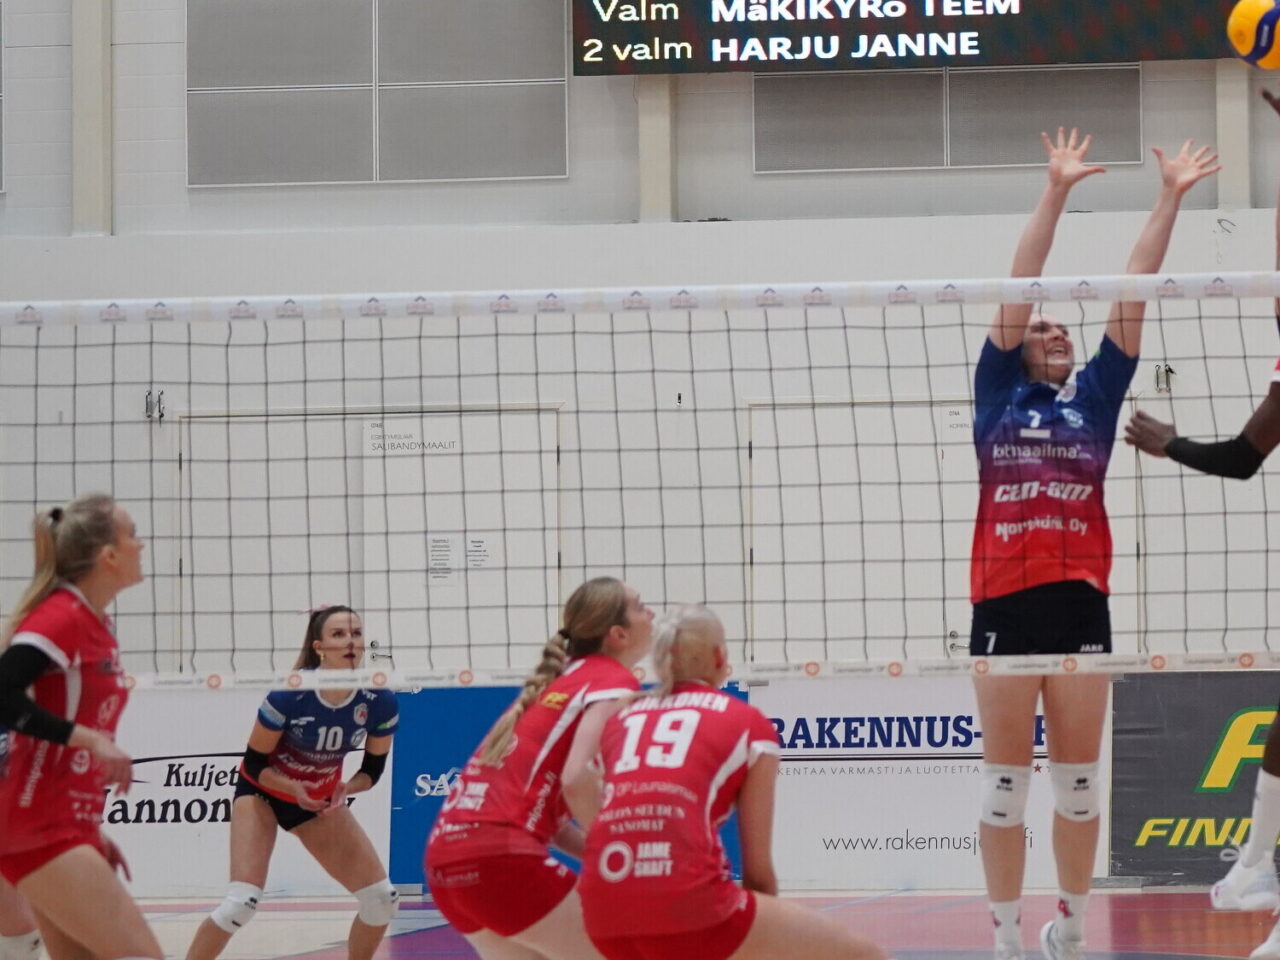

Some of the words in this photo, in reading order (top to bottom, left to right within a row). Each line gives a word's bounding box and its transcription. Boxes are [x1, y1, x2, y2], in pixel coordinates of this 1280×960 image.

[584, 39, 602, 61] 2
[613, 37, 692, 60] valm
[712, 36, 839, 61] HARJU
[851, 32, 979, 58] JANNE
[985, 632, 997, 654] 7
[315, 726, 344, 751] 10
[614, 709, 701, 775] 19
[898, 766, 912, 775] JA
